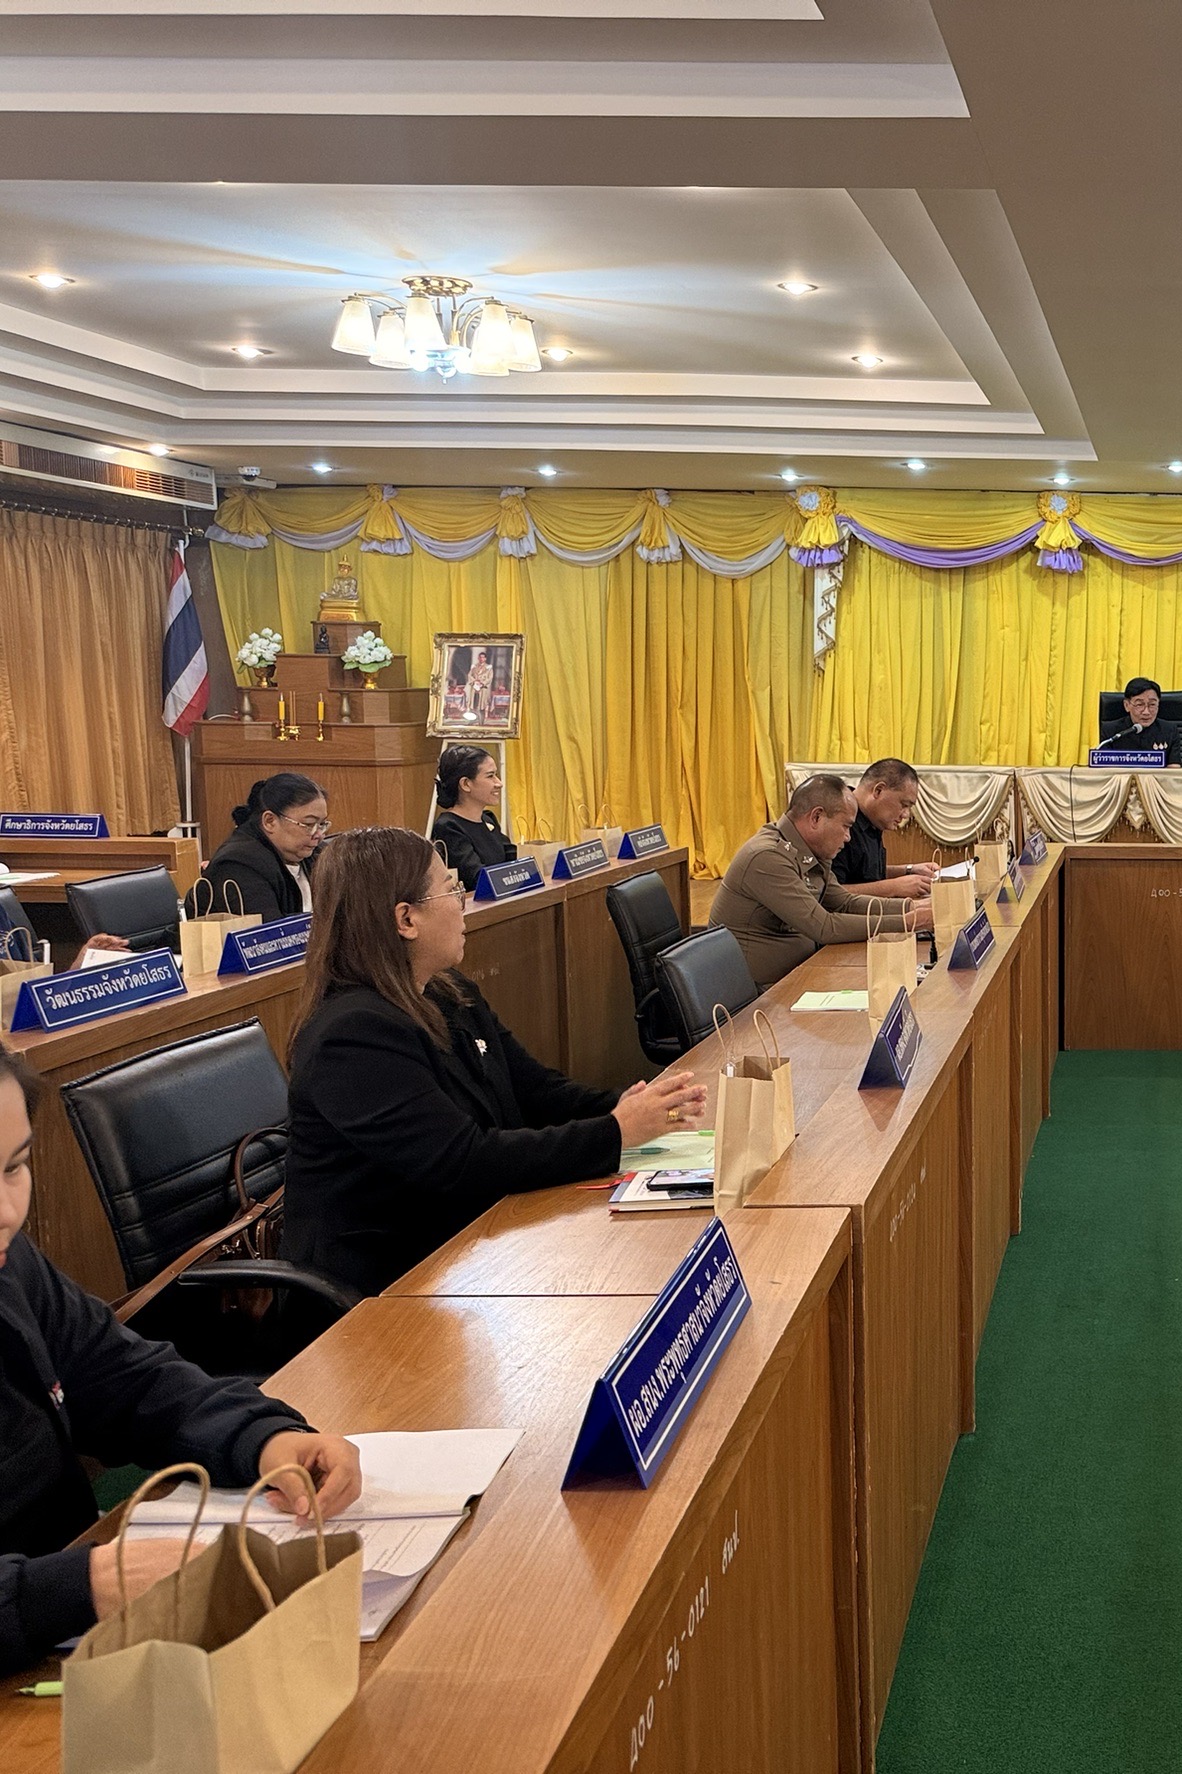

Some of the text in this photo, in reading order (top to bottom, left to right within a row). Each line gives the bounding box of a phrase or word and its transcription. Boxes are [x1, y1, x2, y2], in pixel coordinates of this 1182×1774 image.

[1093, 752, 1162, 764] ผู้ว่าราชการจังหวัดยโสธร
[5, 819, 93, 831] ศึกษาธิการจังหวัดยโสธร
[46, 964, 172, 1010] วัฒนธรรมจังหวัดยโสธร
[627, 1255, 739, 1437] ผอ.สนง.พระพุทธศาสนาจังหวัดยโสธร
